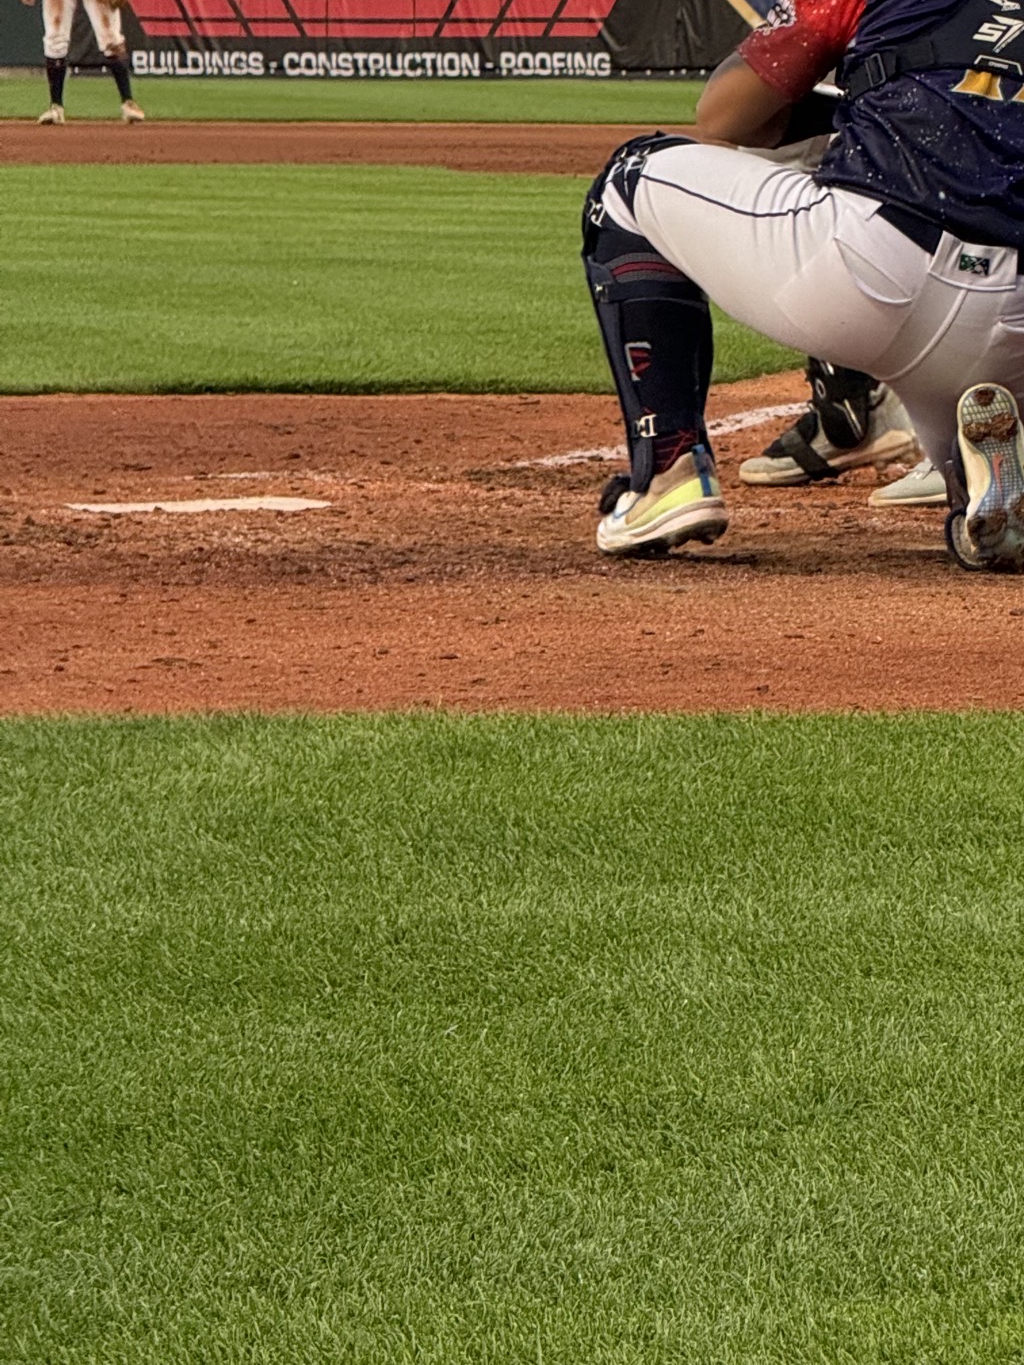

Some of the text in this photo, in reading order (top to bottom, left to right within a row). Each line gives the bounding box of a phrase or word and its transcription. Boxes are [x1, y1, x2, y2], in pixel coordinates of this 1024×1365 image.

[132, 51, 264, 75] BUILDINGS
[283, 52, 480, 77] CONSTRUCTION
[500, 52, 612, 77] ROOFING
